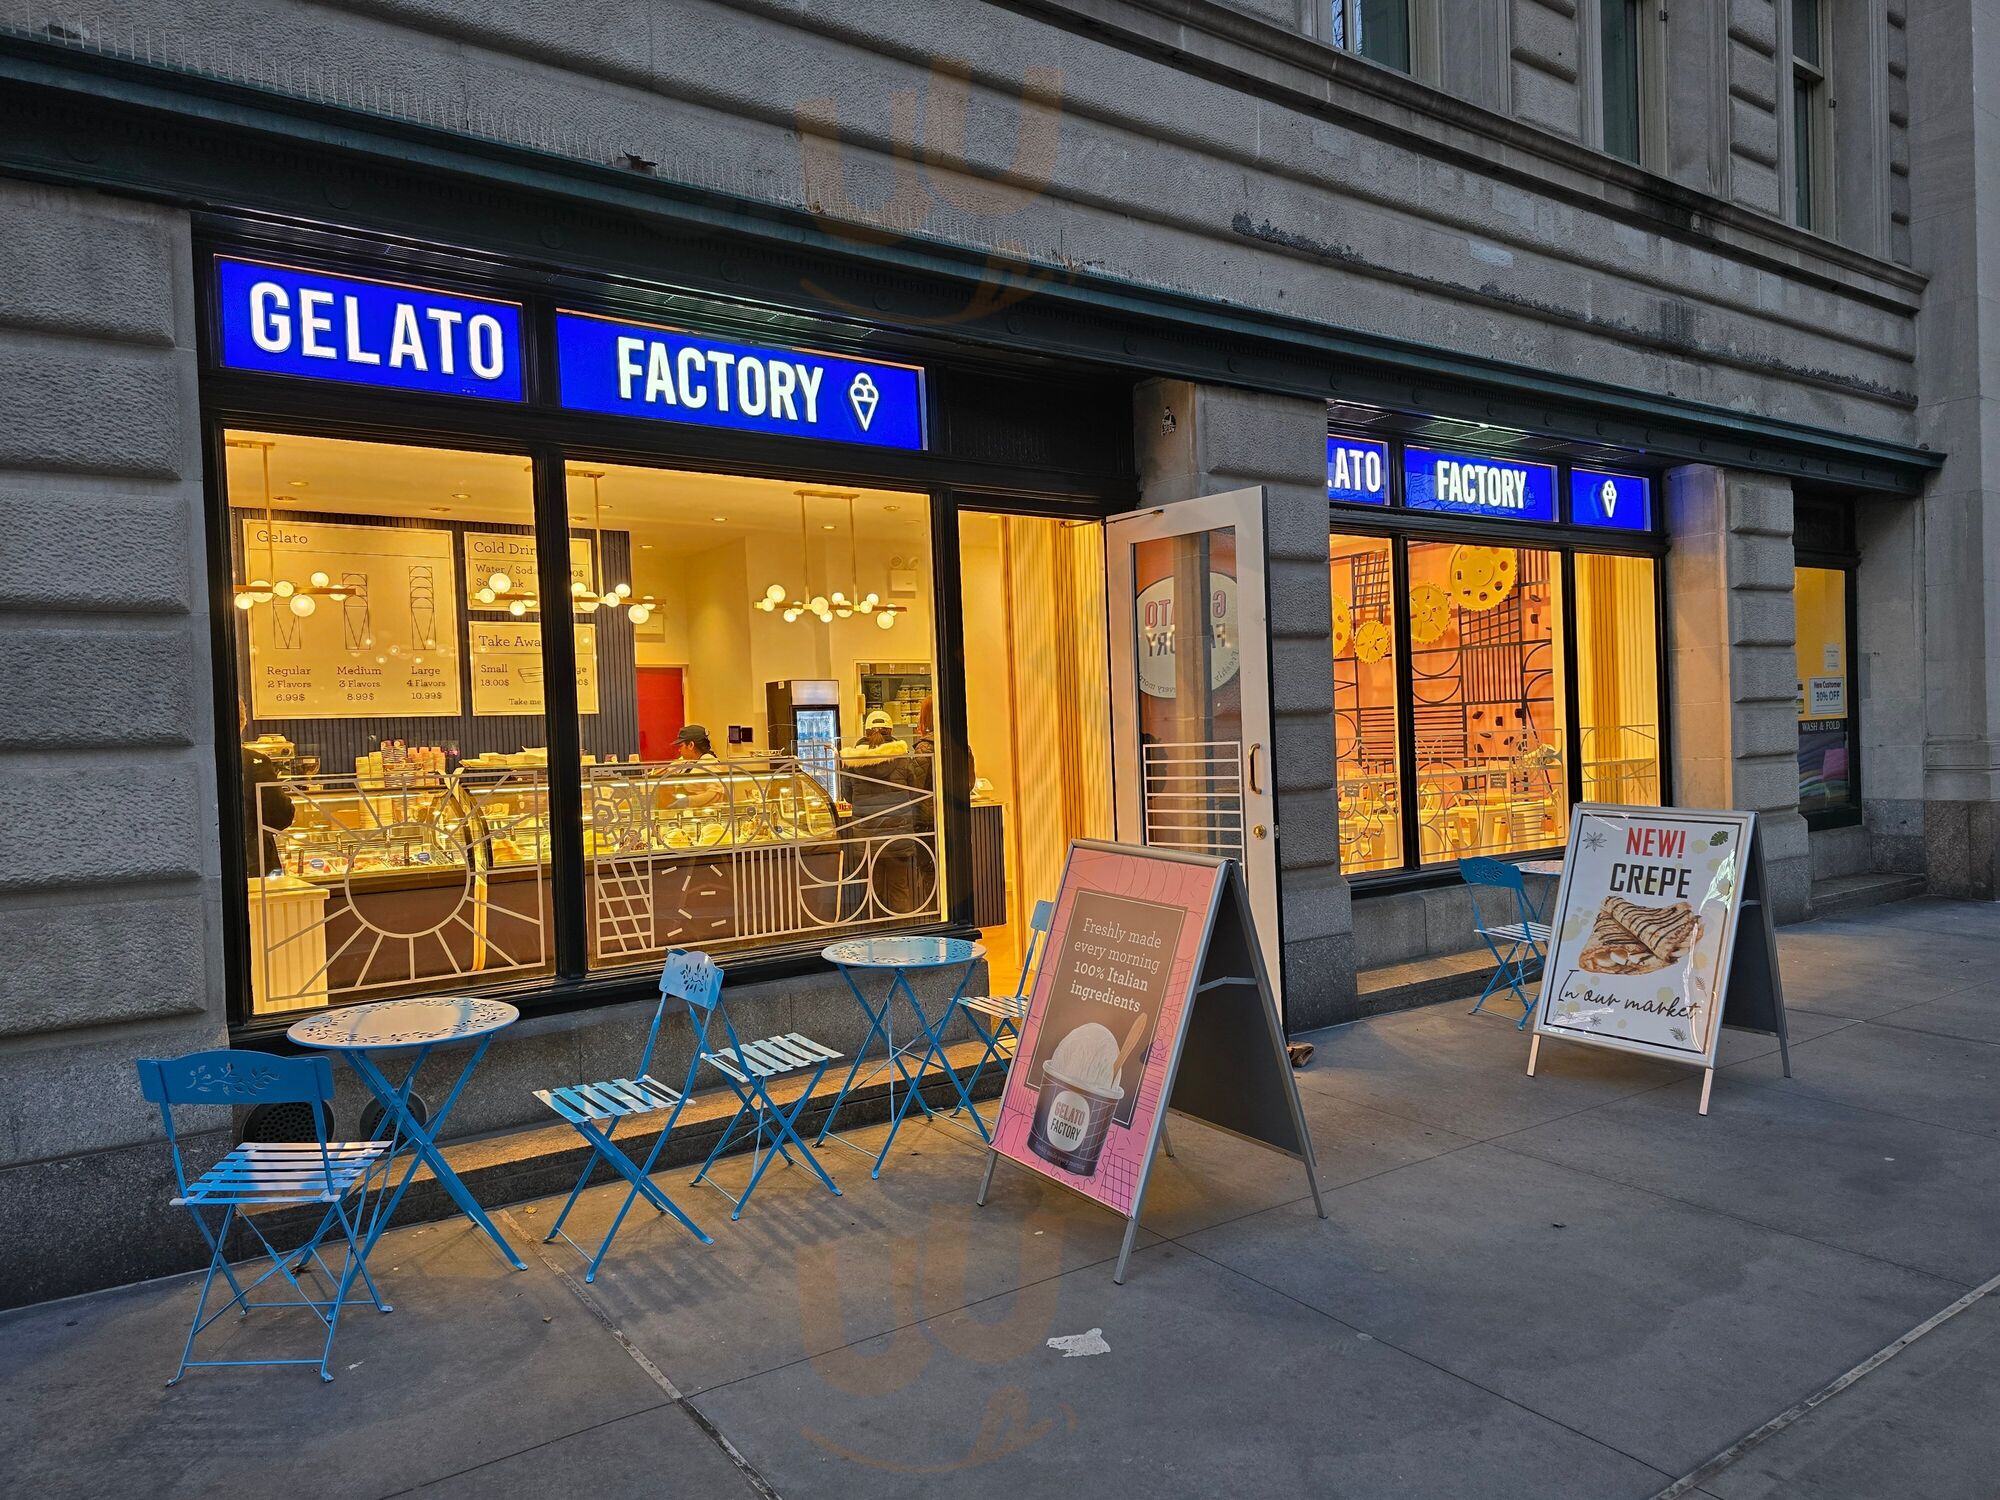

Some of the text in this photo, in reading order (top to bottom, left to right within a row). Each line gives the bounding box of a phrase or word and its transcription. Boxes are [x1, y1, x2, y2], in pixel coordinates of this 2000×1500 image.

[250, 281, 824, 423] GELATO FACTORY
[1328, 447, 1527, 509] ATO FACTORY
[256, 529, 308, 545] Gelato
[474, 541, 537, 555] Cold Drin
[476, 563, 506, 574] Water
[479, 635, 541, 647] Take Awa
[267, 665, 311, 677] Regular
[337, 666, 382, 676] Medium
[411, 665, 441, 676] Large
[481, 664, 508, 673] Small
[267, 680, 312, 688] 2 Flavors
[338, 680, 381, 688] 3 Flavors
[406, 679, 446, 687] 4 Flavors
[481, 679, 510, 687] 18.00$
[1823, 681, 1842, 689] Customer
[276, 693, 305, 702] 6.99$
[347, 692, 375, 701] 8.99$
[411, 692, 442, 700] 10.99$
[1816, 690, 1840, 701] 30% OFF
[509, 698, 528, 706] Take
[1802, 720, 1841, 731] WASH & FOLD
[1625, 827, 1686, 859] NEW!
[1609, 863, 1692, 899] CREPE
[1083, 917, 1161, 948] Freshly made
[1074, 941, 1160, 975] every morning
[1074, 961, 1148, 991] 100% Italian
[1070, 979, 1141, 1013] ingredients
[1557, 969, 1700, 1020] In our market
[1054, 1102, 1086, 1127] GELATO
[1050, 1118, 1082, 1142] FACTORY
